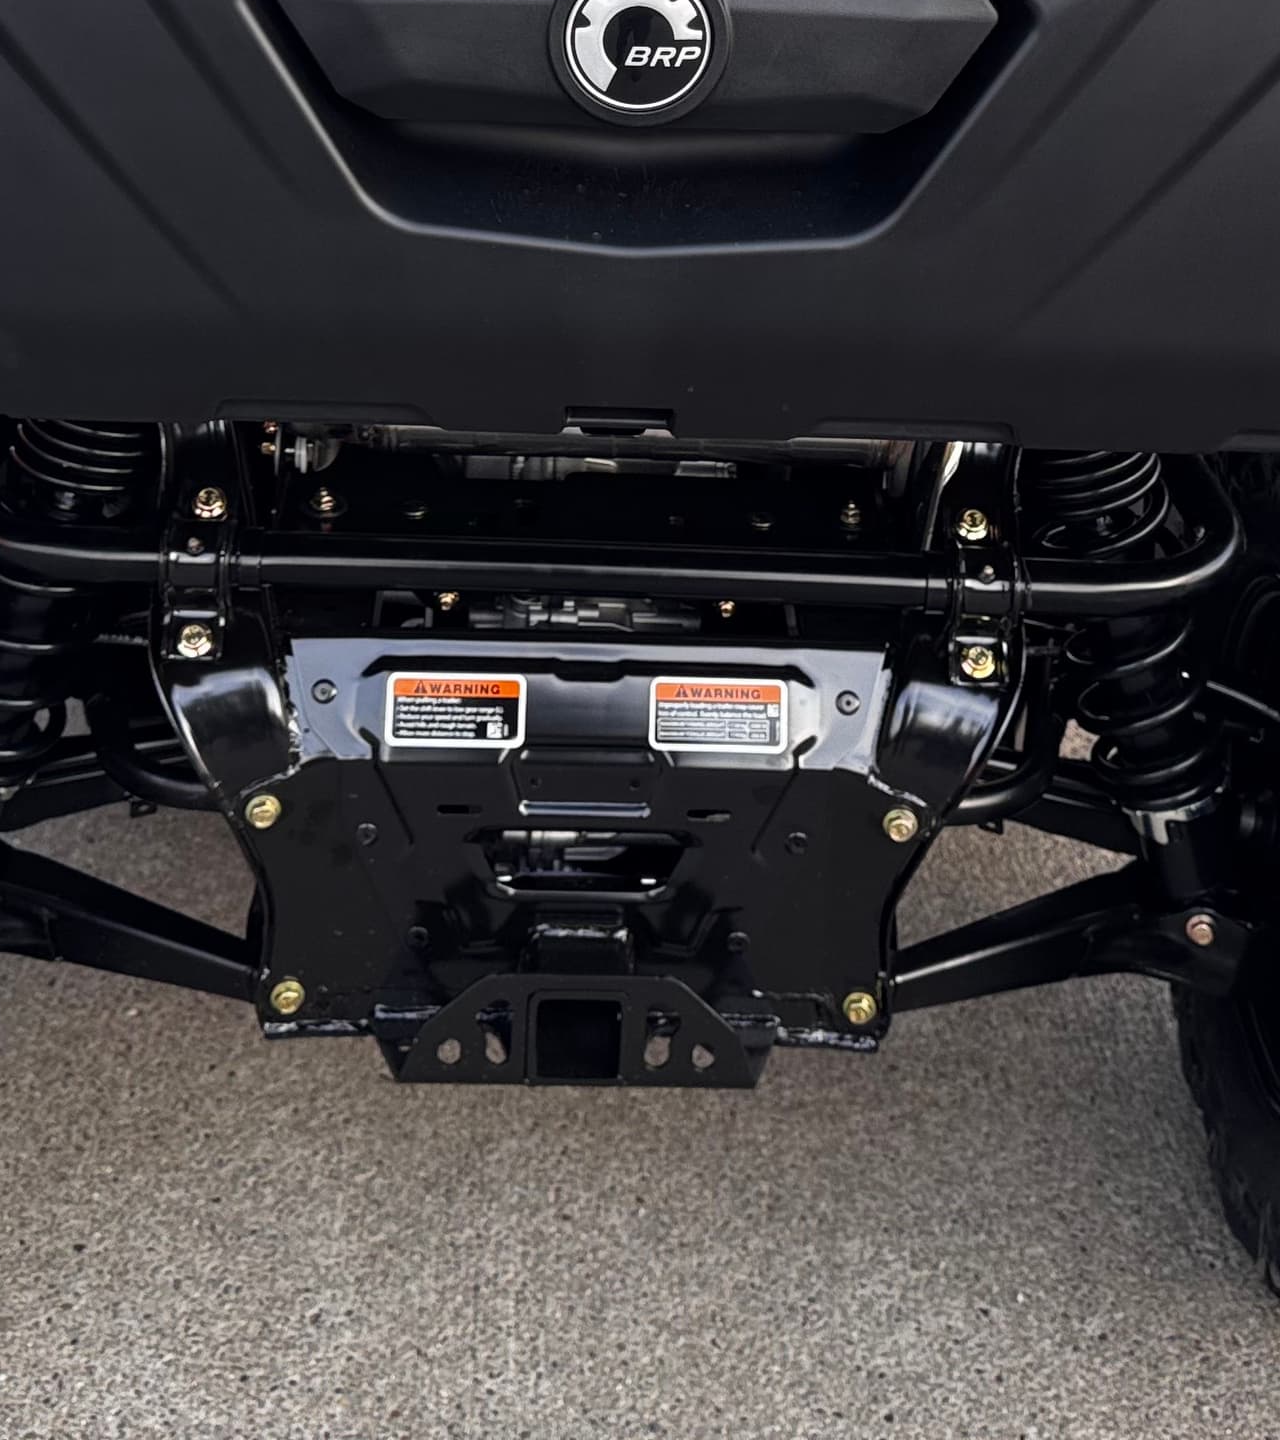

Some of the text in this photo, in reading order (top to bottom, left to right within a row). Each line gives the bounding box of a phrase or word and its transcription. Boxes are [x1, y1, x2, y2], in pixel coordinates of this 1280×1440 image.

[624, 46, 702, 67] BRP
[429, 683, 501, 695] WARNING
[690, 687, 761, 699] WARNING
